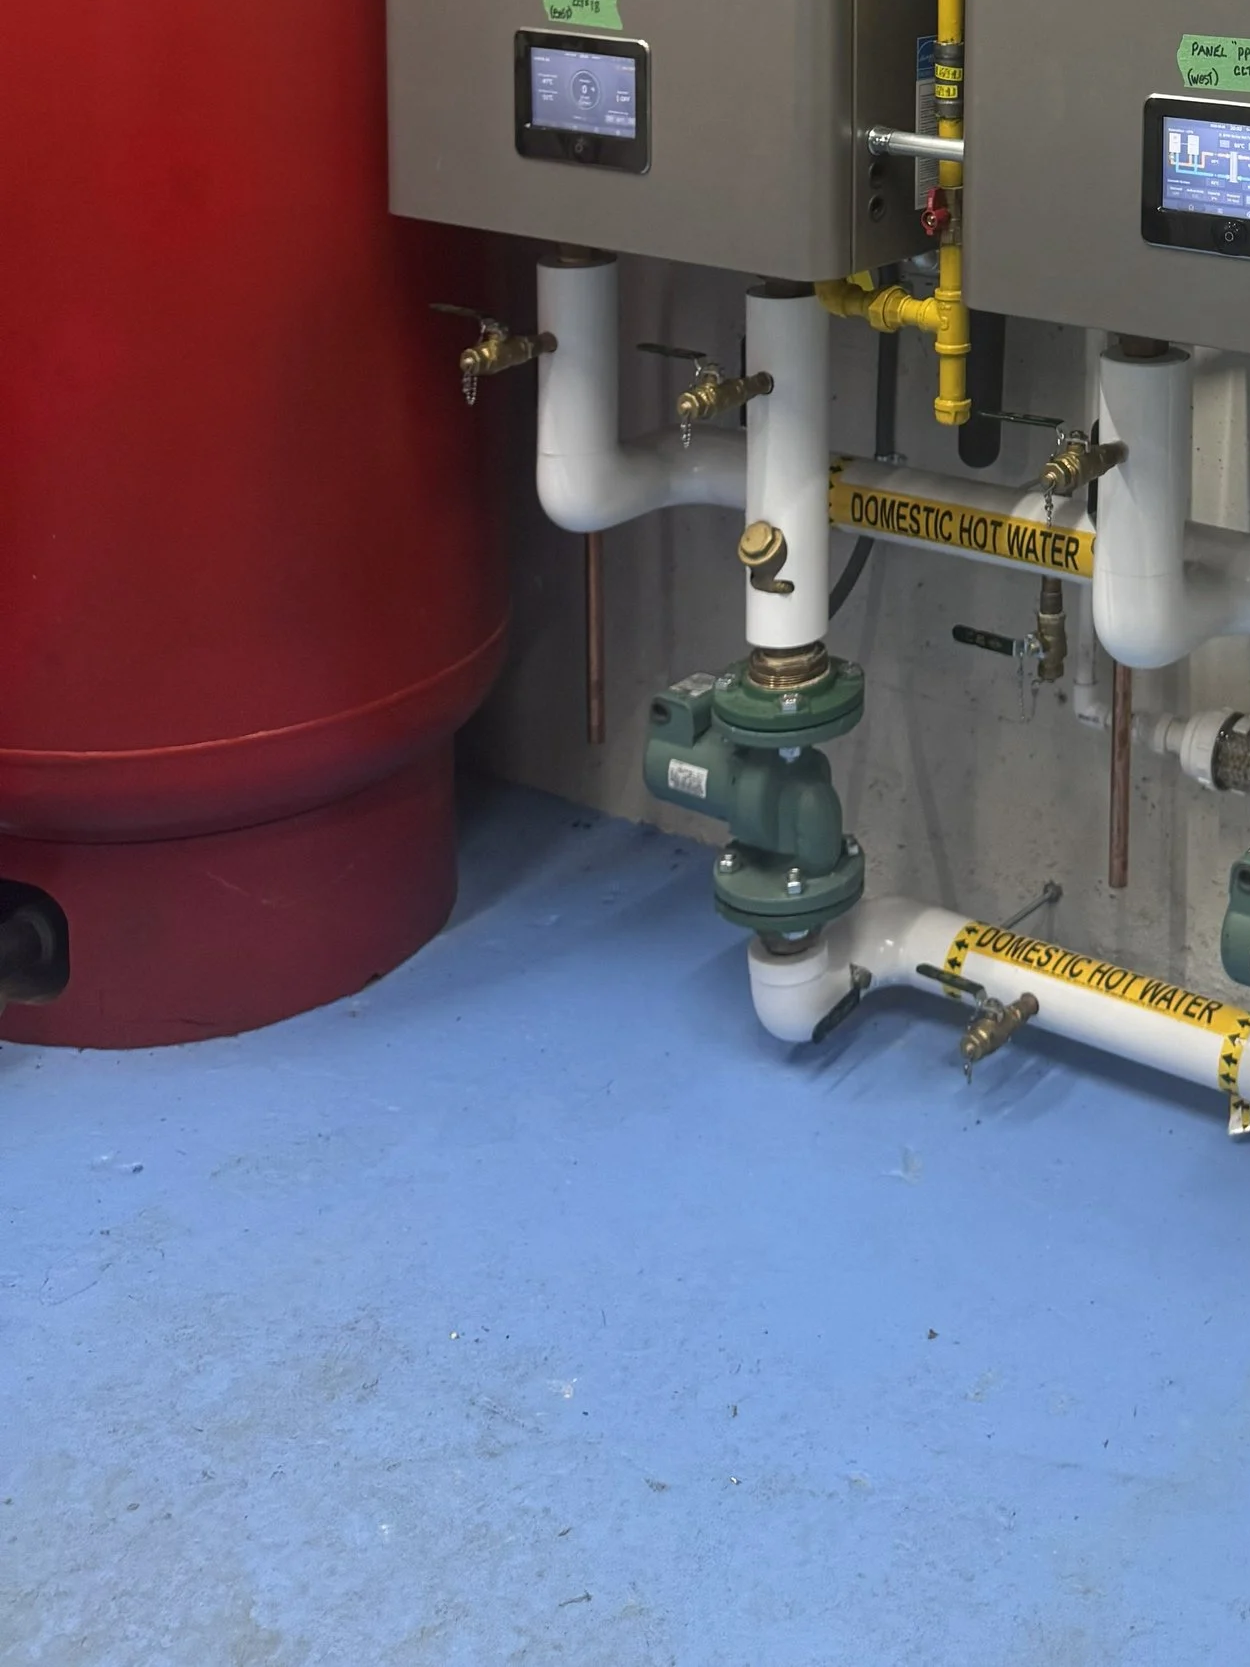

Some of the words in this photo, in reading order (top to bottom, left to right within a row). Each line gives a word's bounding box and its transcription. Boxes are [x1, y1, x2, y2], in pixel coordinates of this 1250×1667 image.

[1191, 41, 1228, 58] PANEL
[850, 491, 953, 543] DOMESTIC
[958, 512, 1004, 555] HOT
[1006, 522, 1080, 572] WATER
[974, 925, 1092, 978] DOMESTIC
[1087, 962, 1140, 994] HOT
[1141, 977, 1224, 1025] WATER
